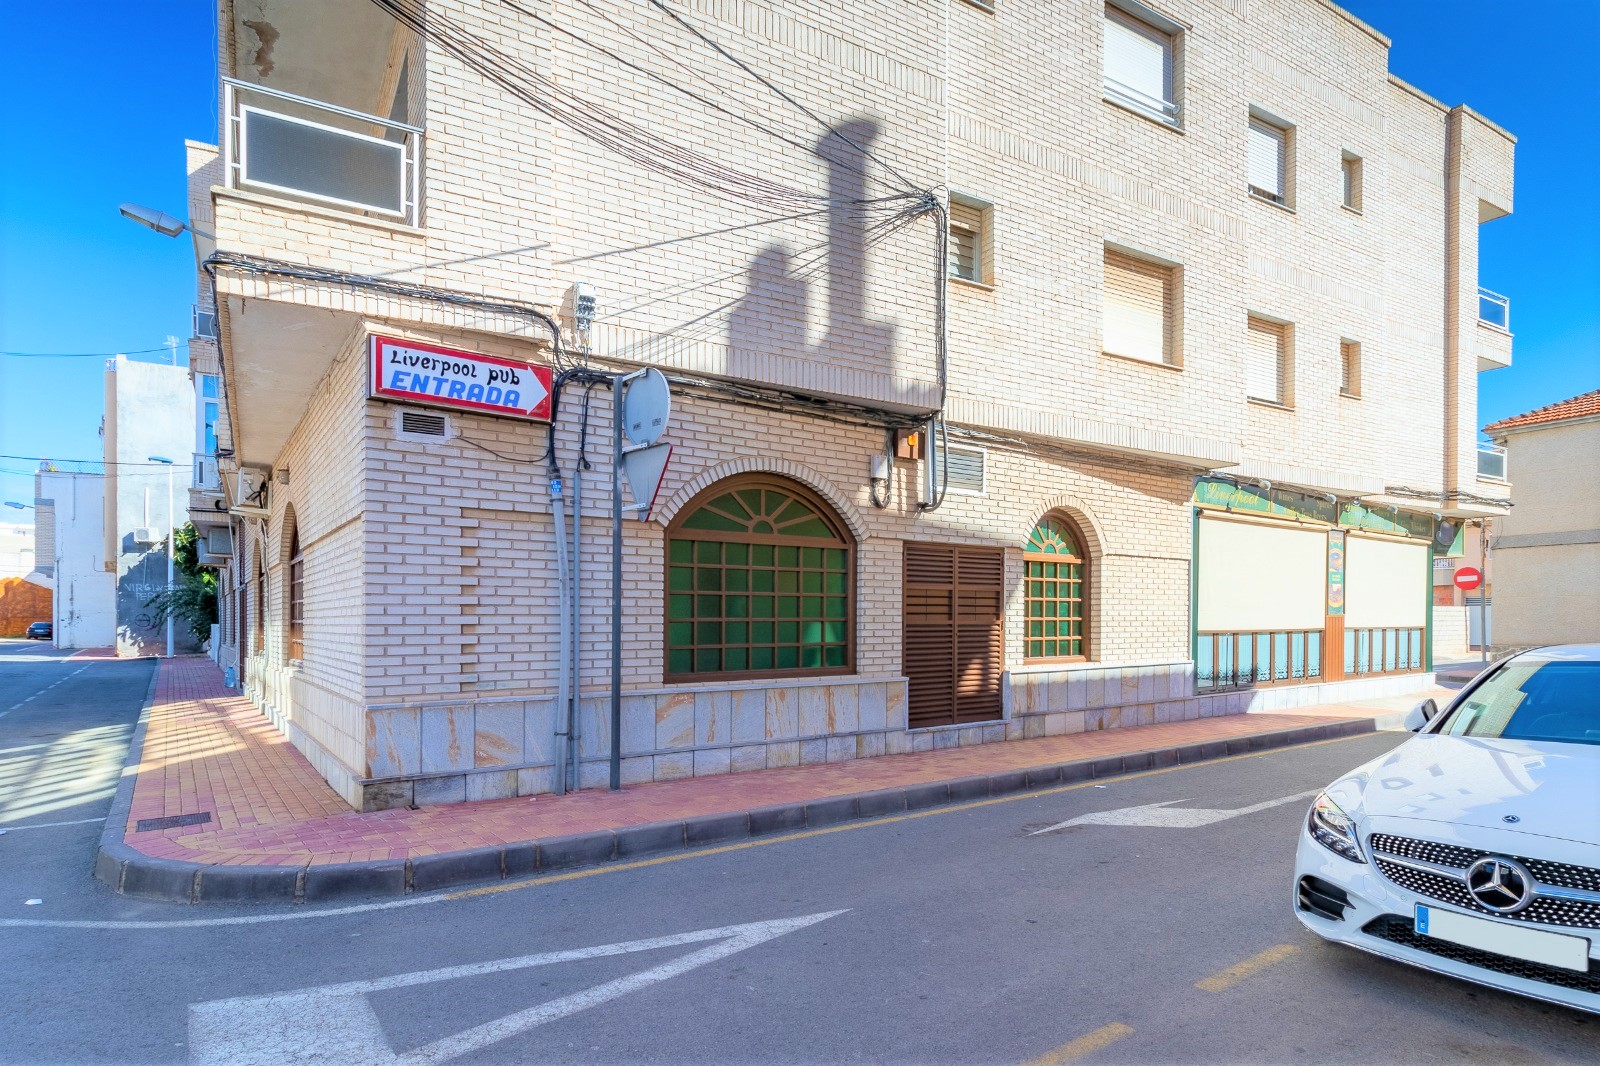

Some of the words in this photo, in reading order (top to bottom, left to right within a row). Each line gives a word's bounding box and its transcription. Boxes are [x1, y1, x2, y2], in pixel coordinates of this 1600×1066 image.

[390, 350, 477, 378] Liverpool
[486, 368, 520, 386] pub
[389, 369, 521, 408] ENTRADA
[1206, 482, 1260, 508] Liverpool
